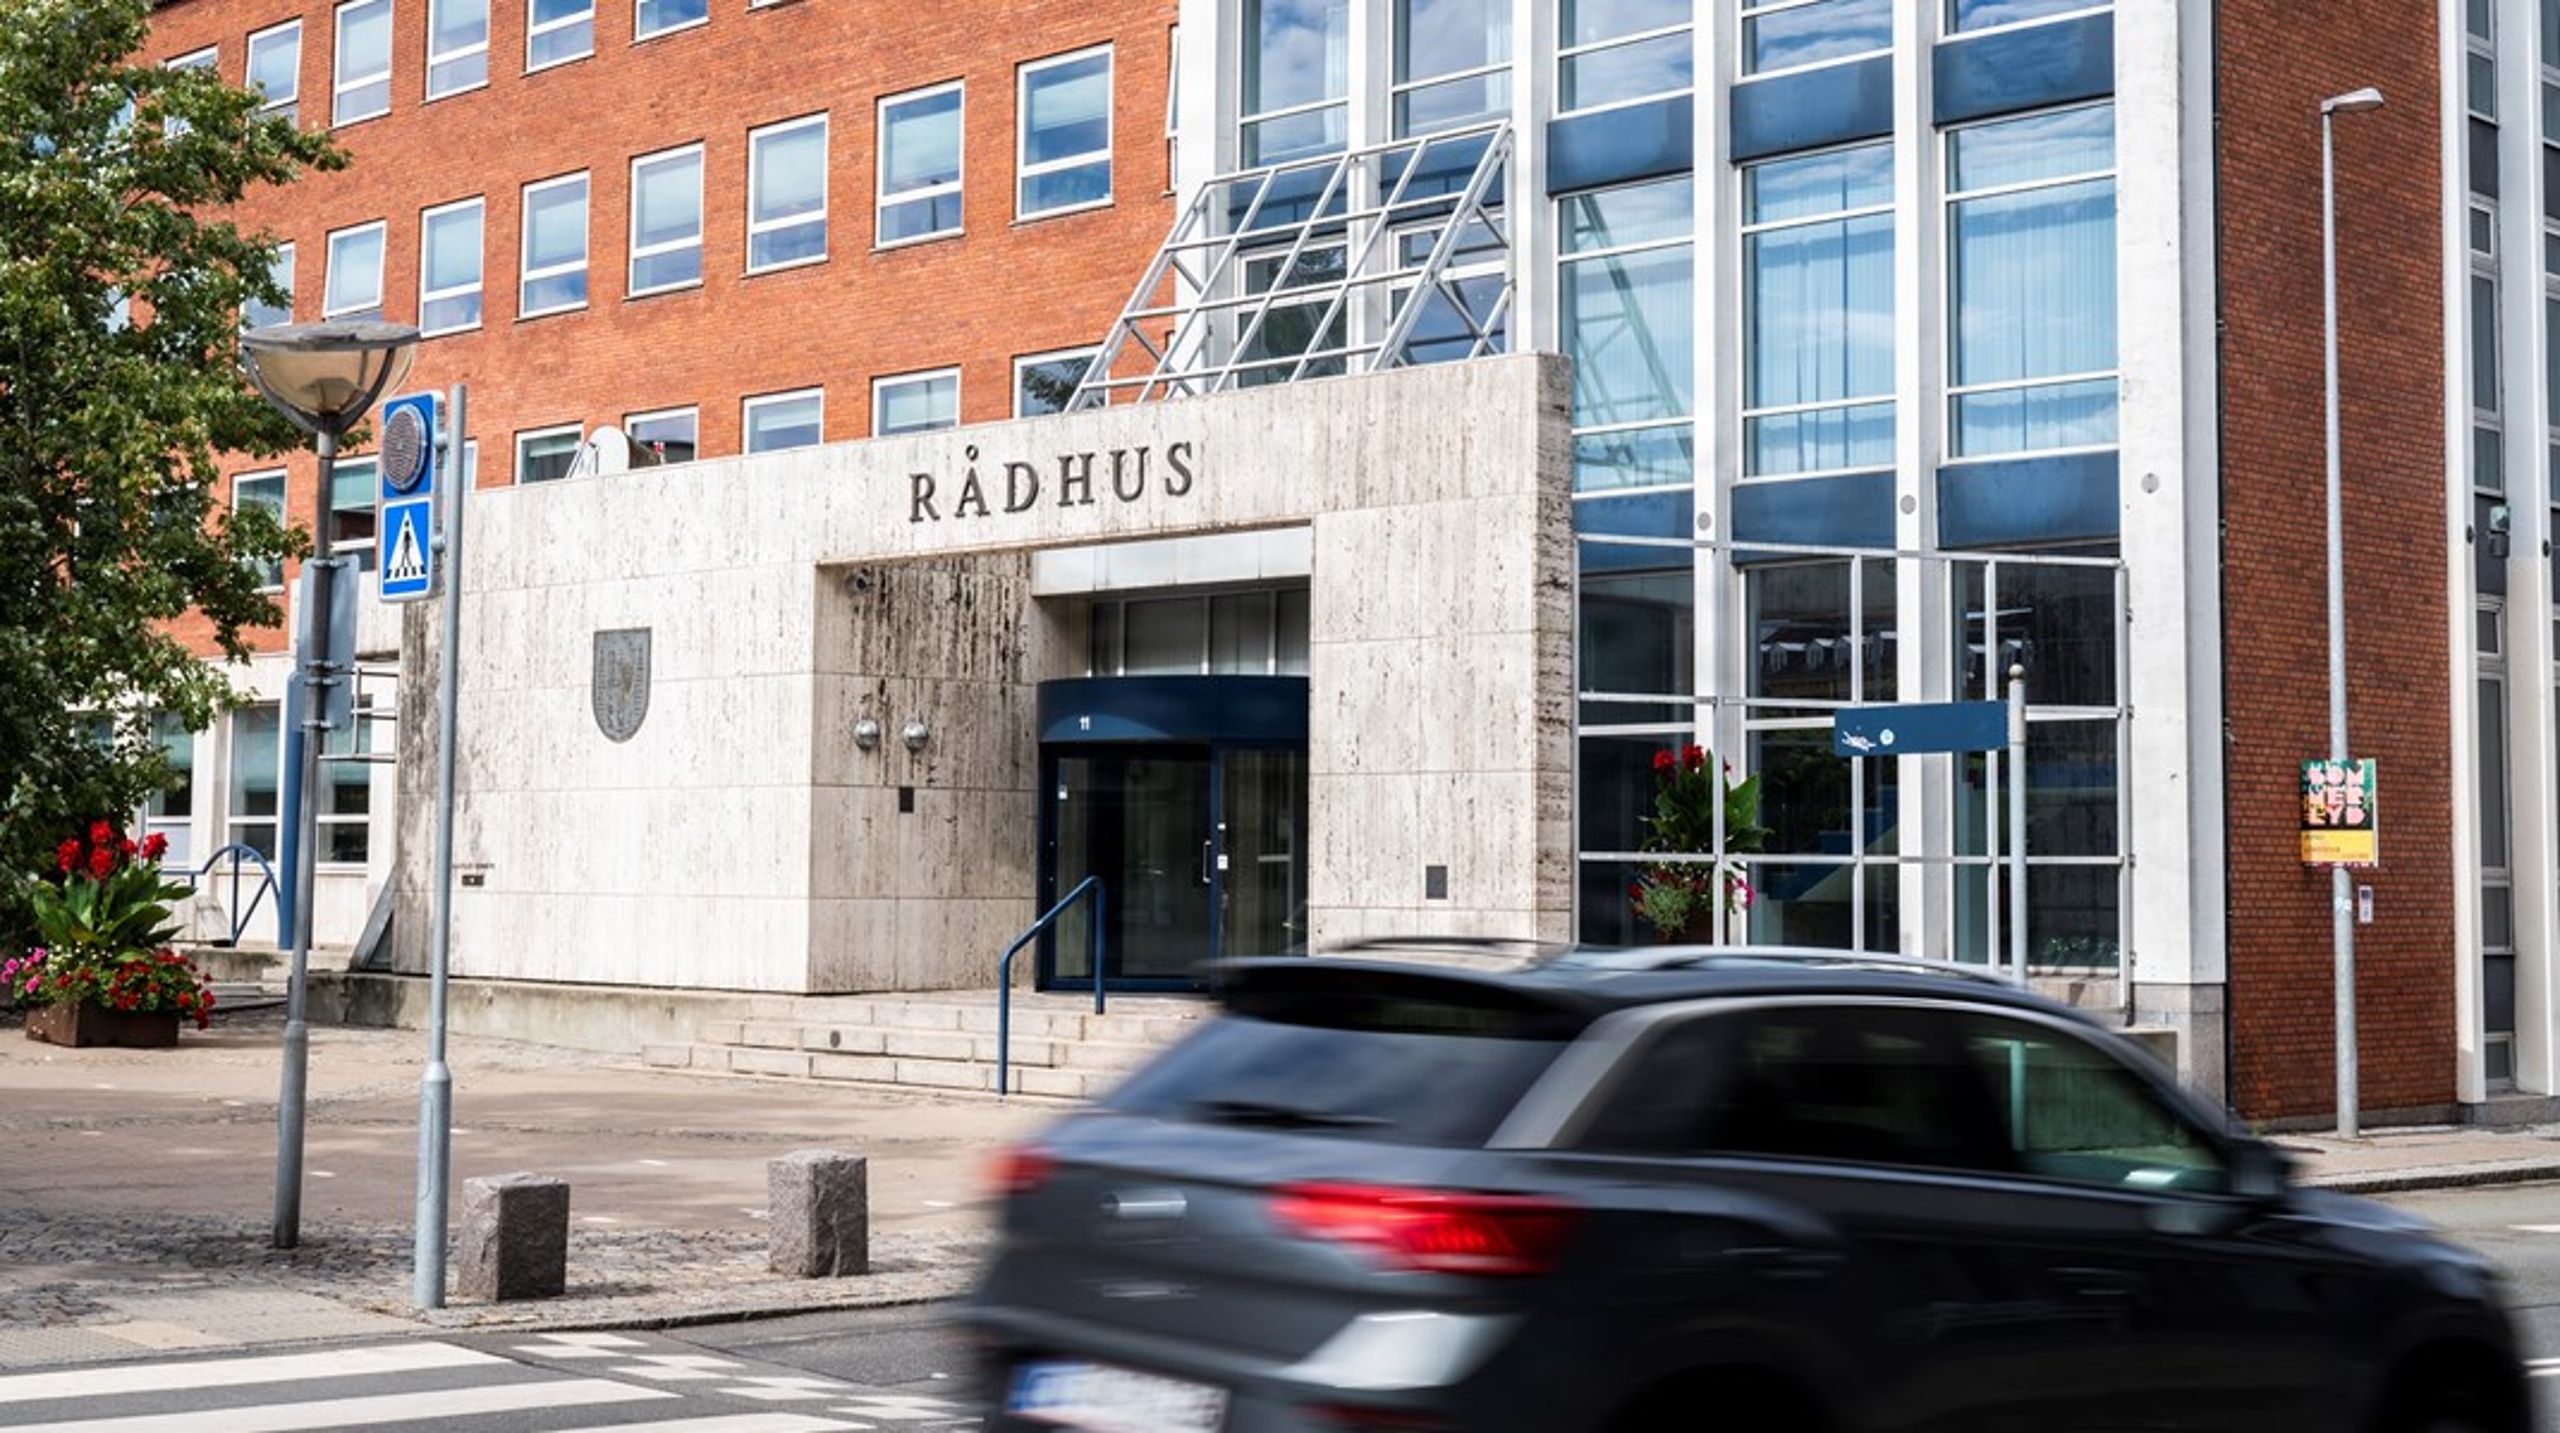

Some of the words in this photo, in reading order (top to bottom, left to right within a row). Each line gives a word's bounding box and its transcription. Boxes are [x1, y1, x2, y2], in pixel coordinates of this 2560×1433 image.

[909, 441, 1193, 522] RÅDHUS
[1079, 716, 1090, 731] 11
[2308, 805, 2365, 825] LYD
